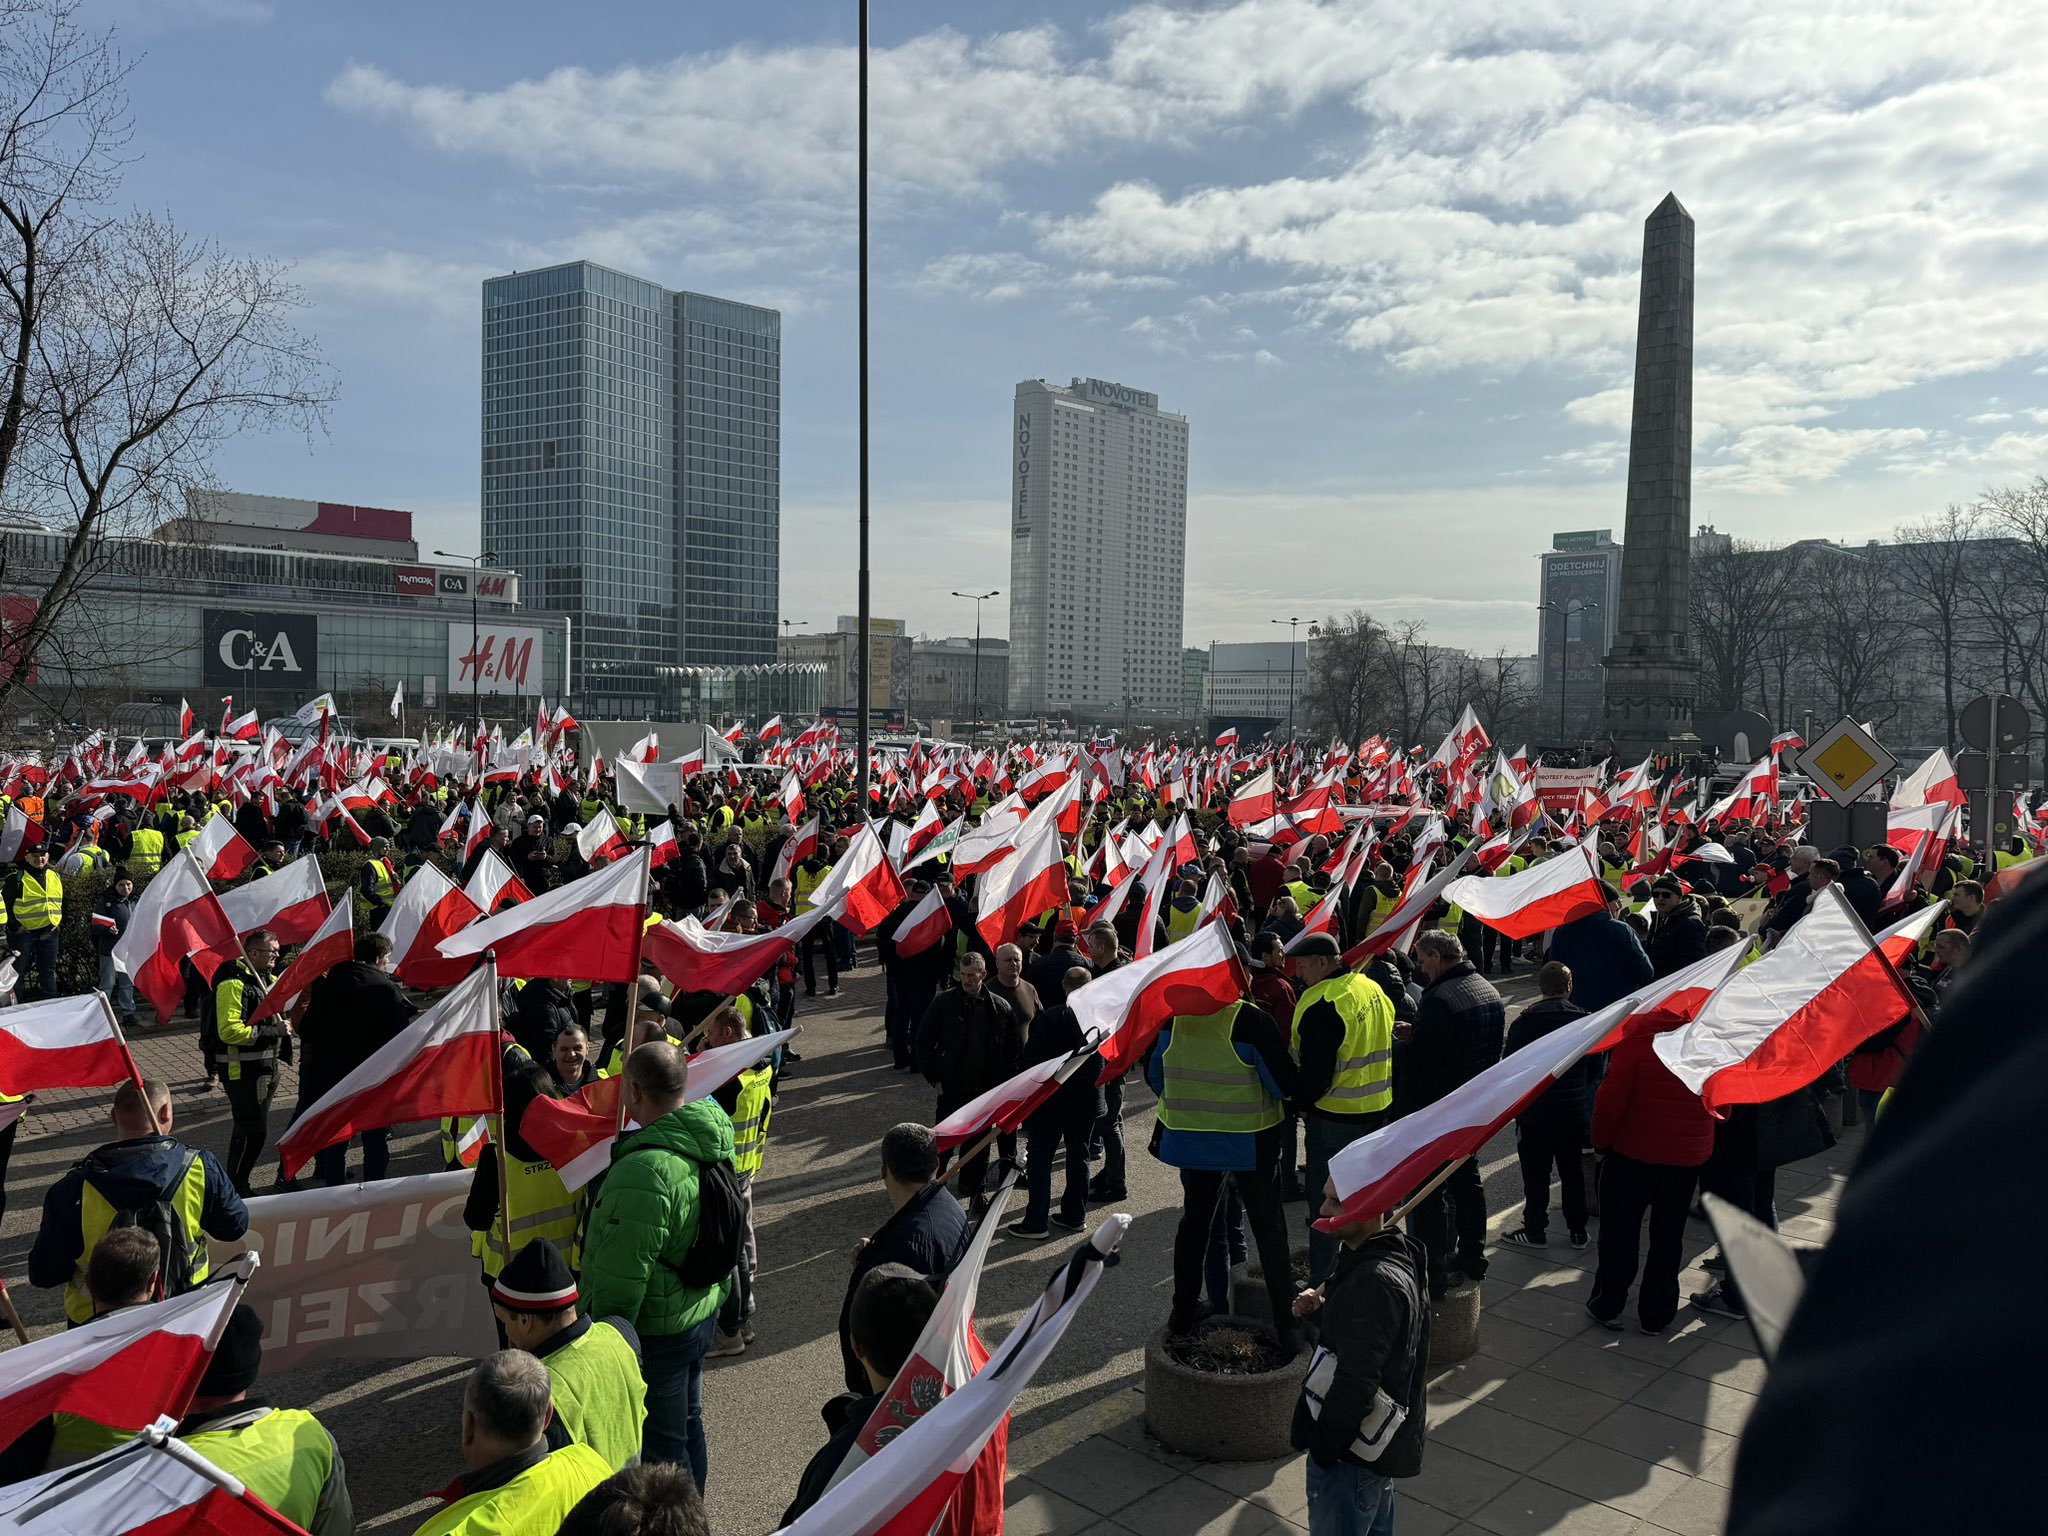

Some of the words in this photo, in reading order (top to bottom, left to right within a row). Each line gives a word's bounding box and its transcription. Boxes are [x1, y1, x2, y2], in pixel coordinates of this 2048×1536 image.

[1091, 379, 1154, 408] NOVOTEL
[1018, 413, 1031, 520] NOVOTEL
[1550, 560, 1605, 571] ODETCHNIJ
[443, 577, 464, 591] C&A
[476, 576, 507, 597] H&M
[218, 628, 302, 672] C&A
[458, 634, 534, 686] H&M
[524, 1162, 550, 1175] STRZ
